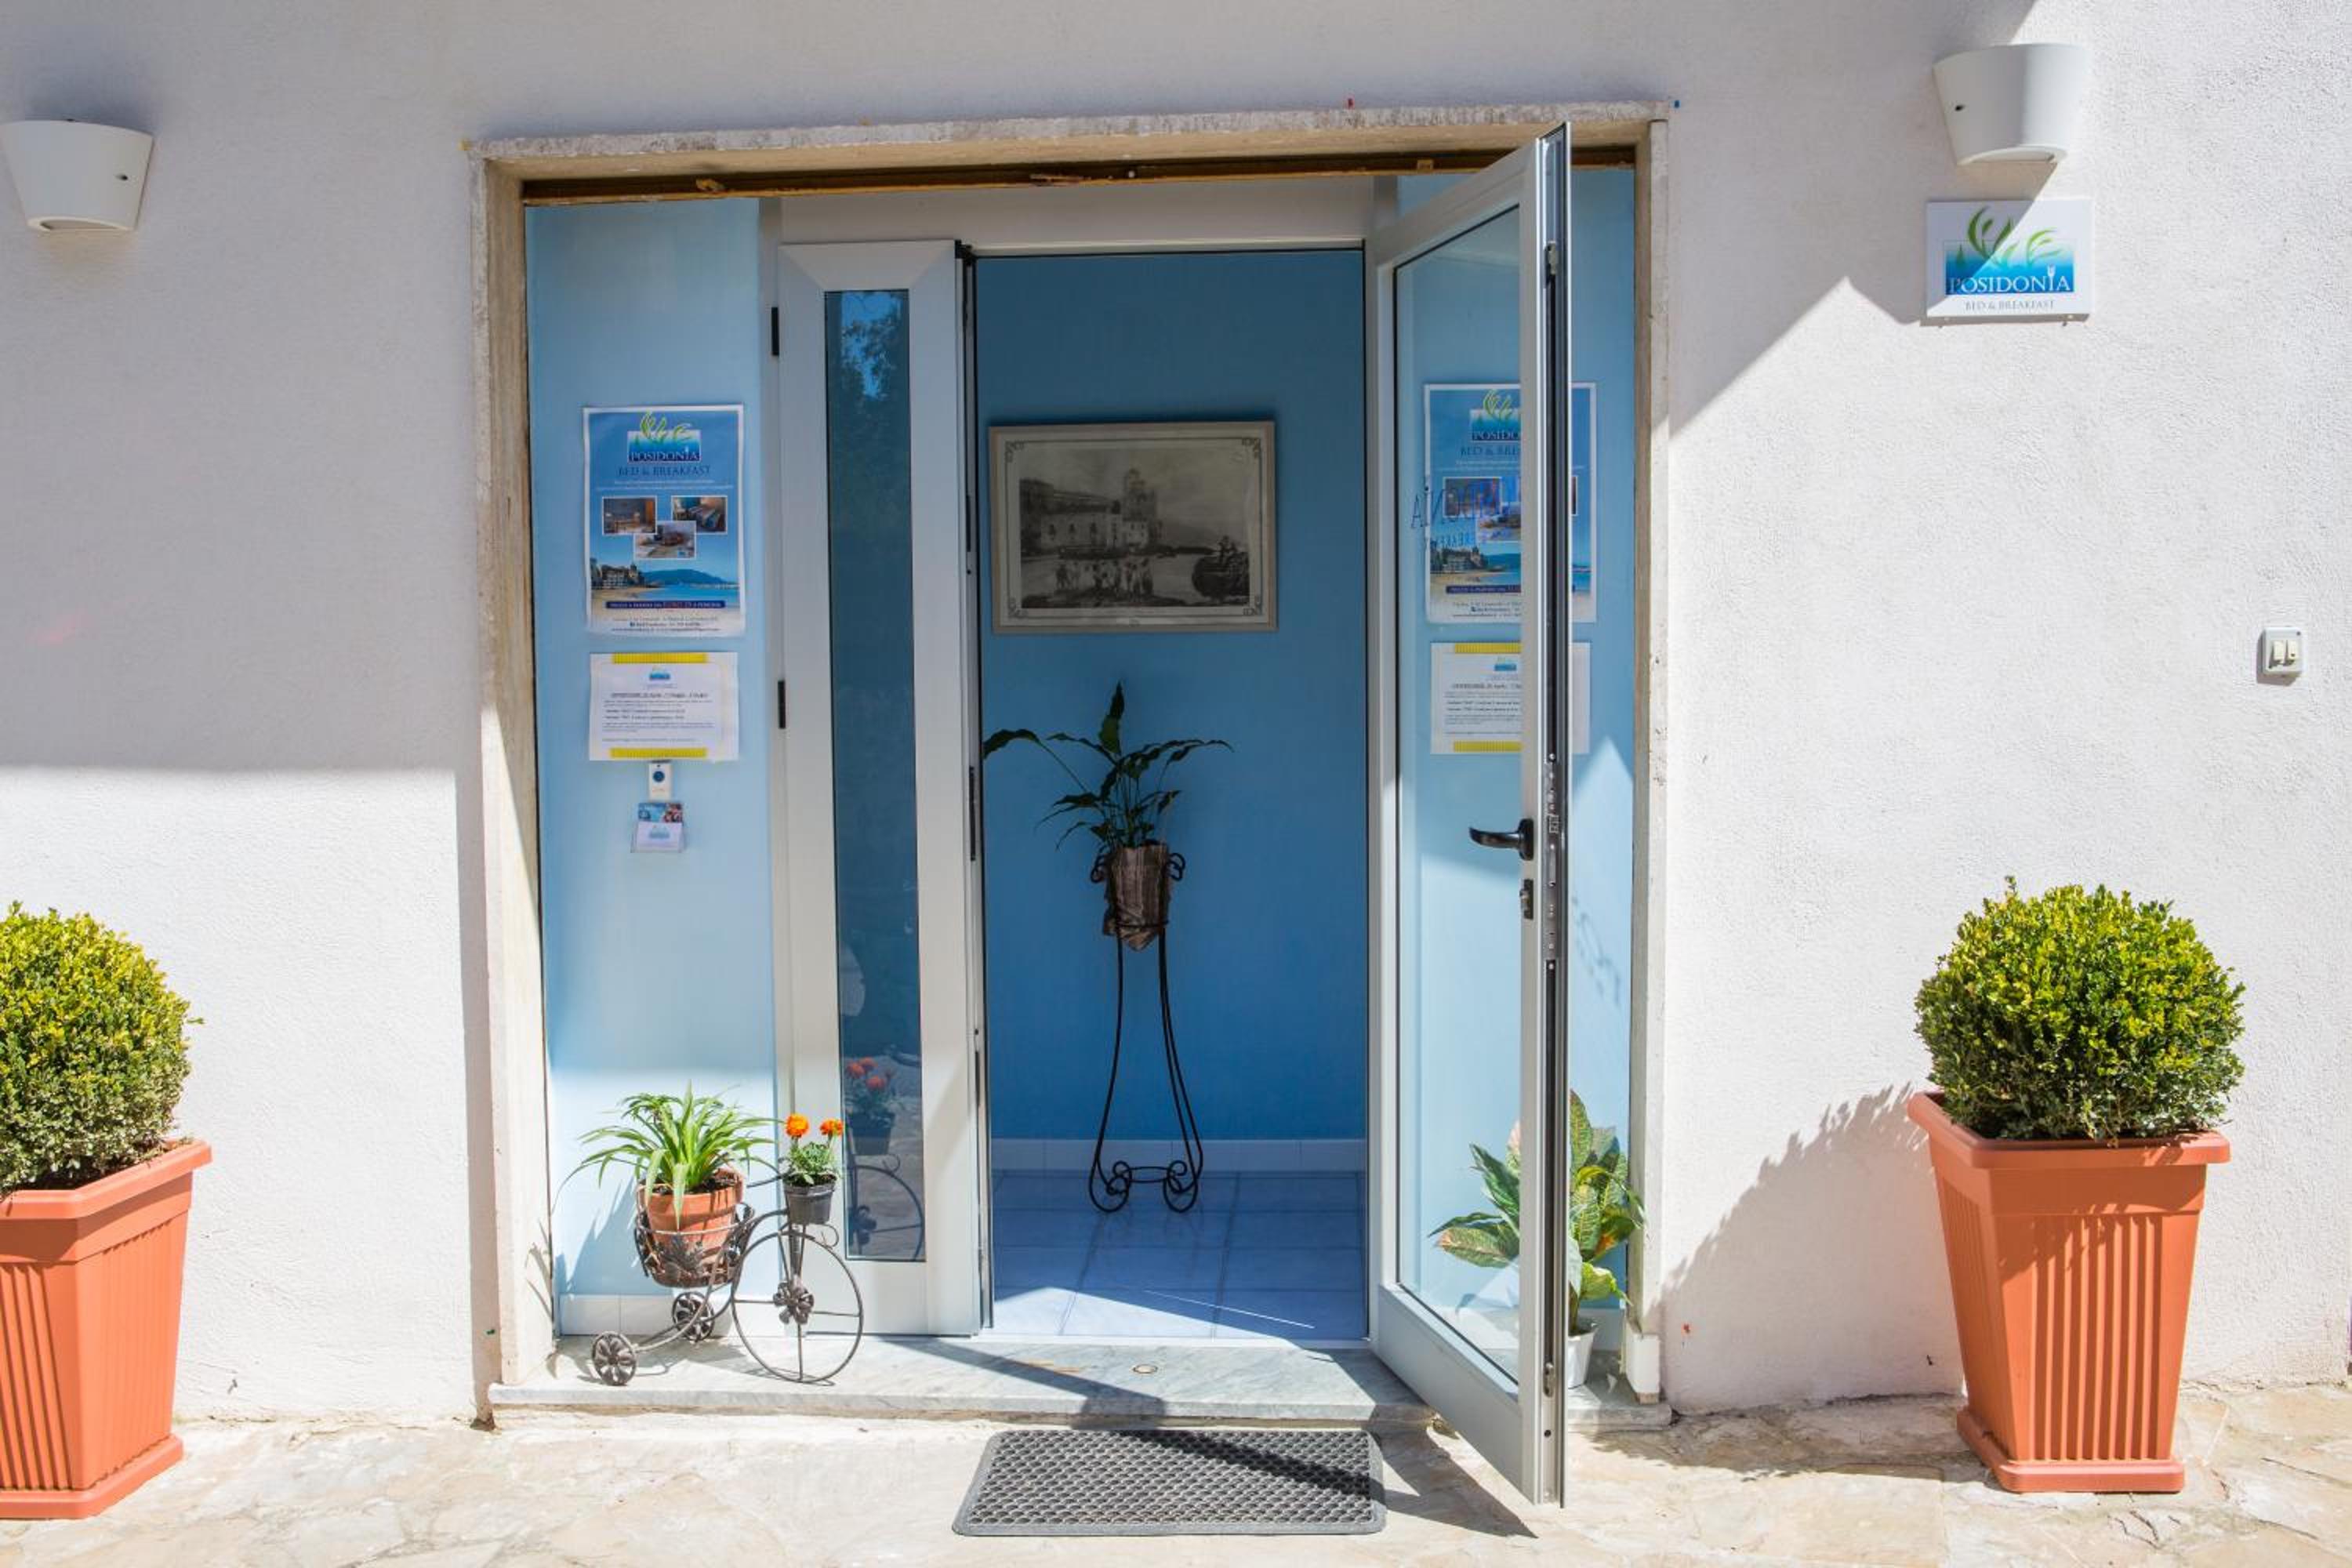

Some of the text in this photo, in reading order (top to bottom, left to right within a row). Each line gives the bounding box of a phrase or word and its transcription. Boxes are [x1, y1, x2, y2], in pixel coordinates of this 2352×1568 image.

[1949, 267, 2071, 293] POSIDONIA
[1965, 300, 1986, 311] BED
[631, 448, 699, 461] POSIDONIA
[619, 465, 640, 476] BED
[652, 464, 711, 476] BREAKFAST
